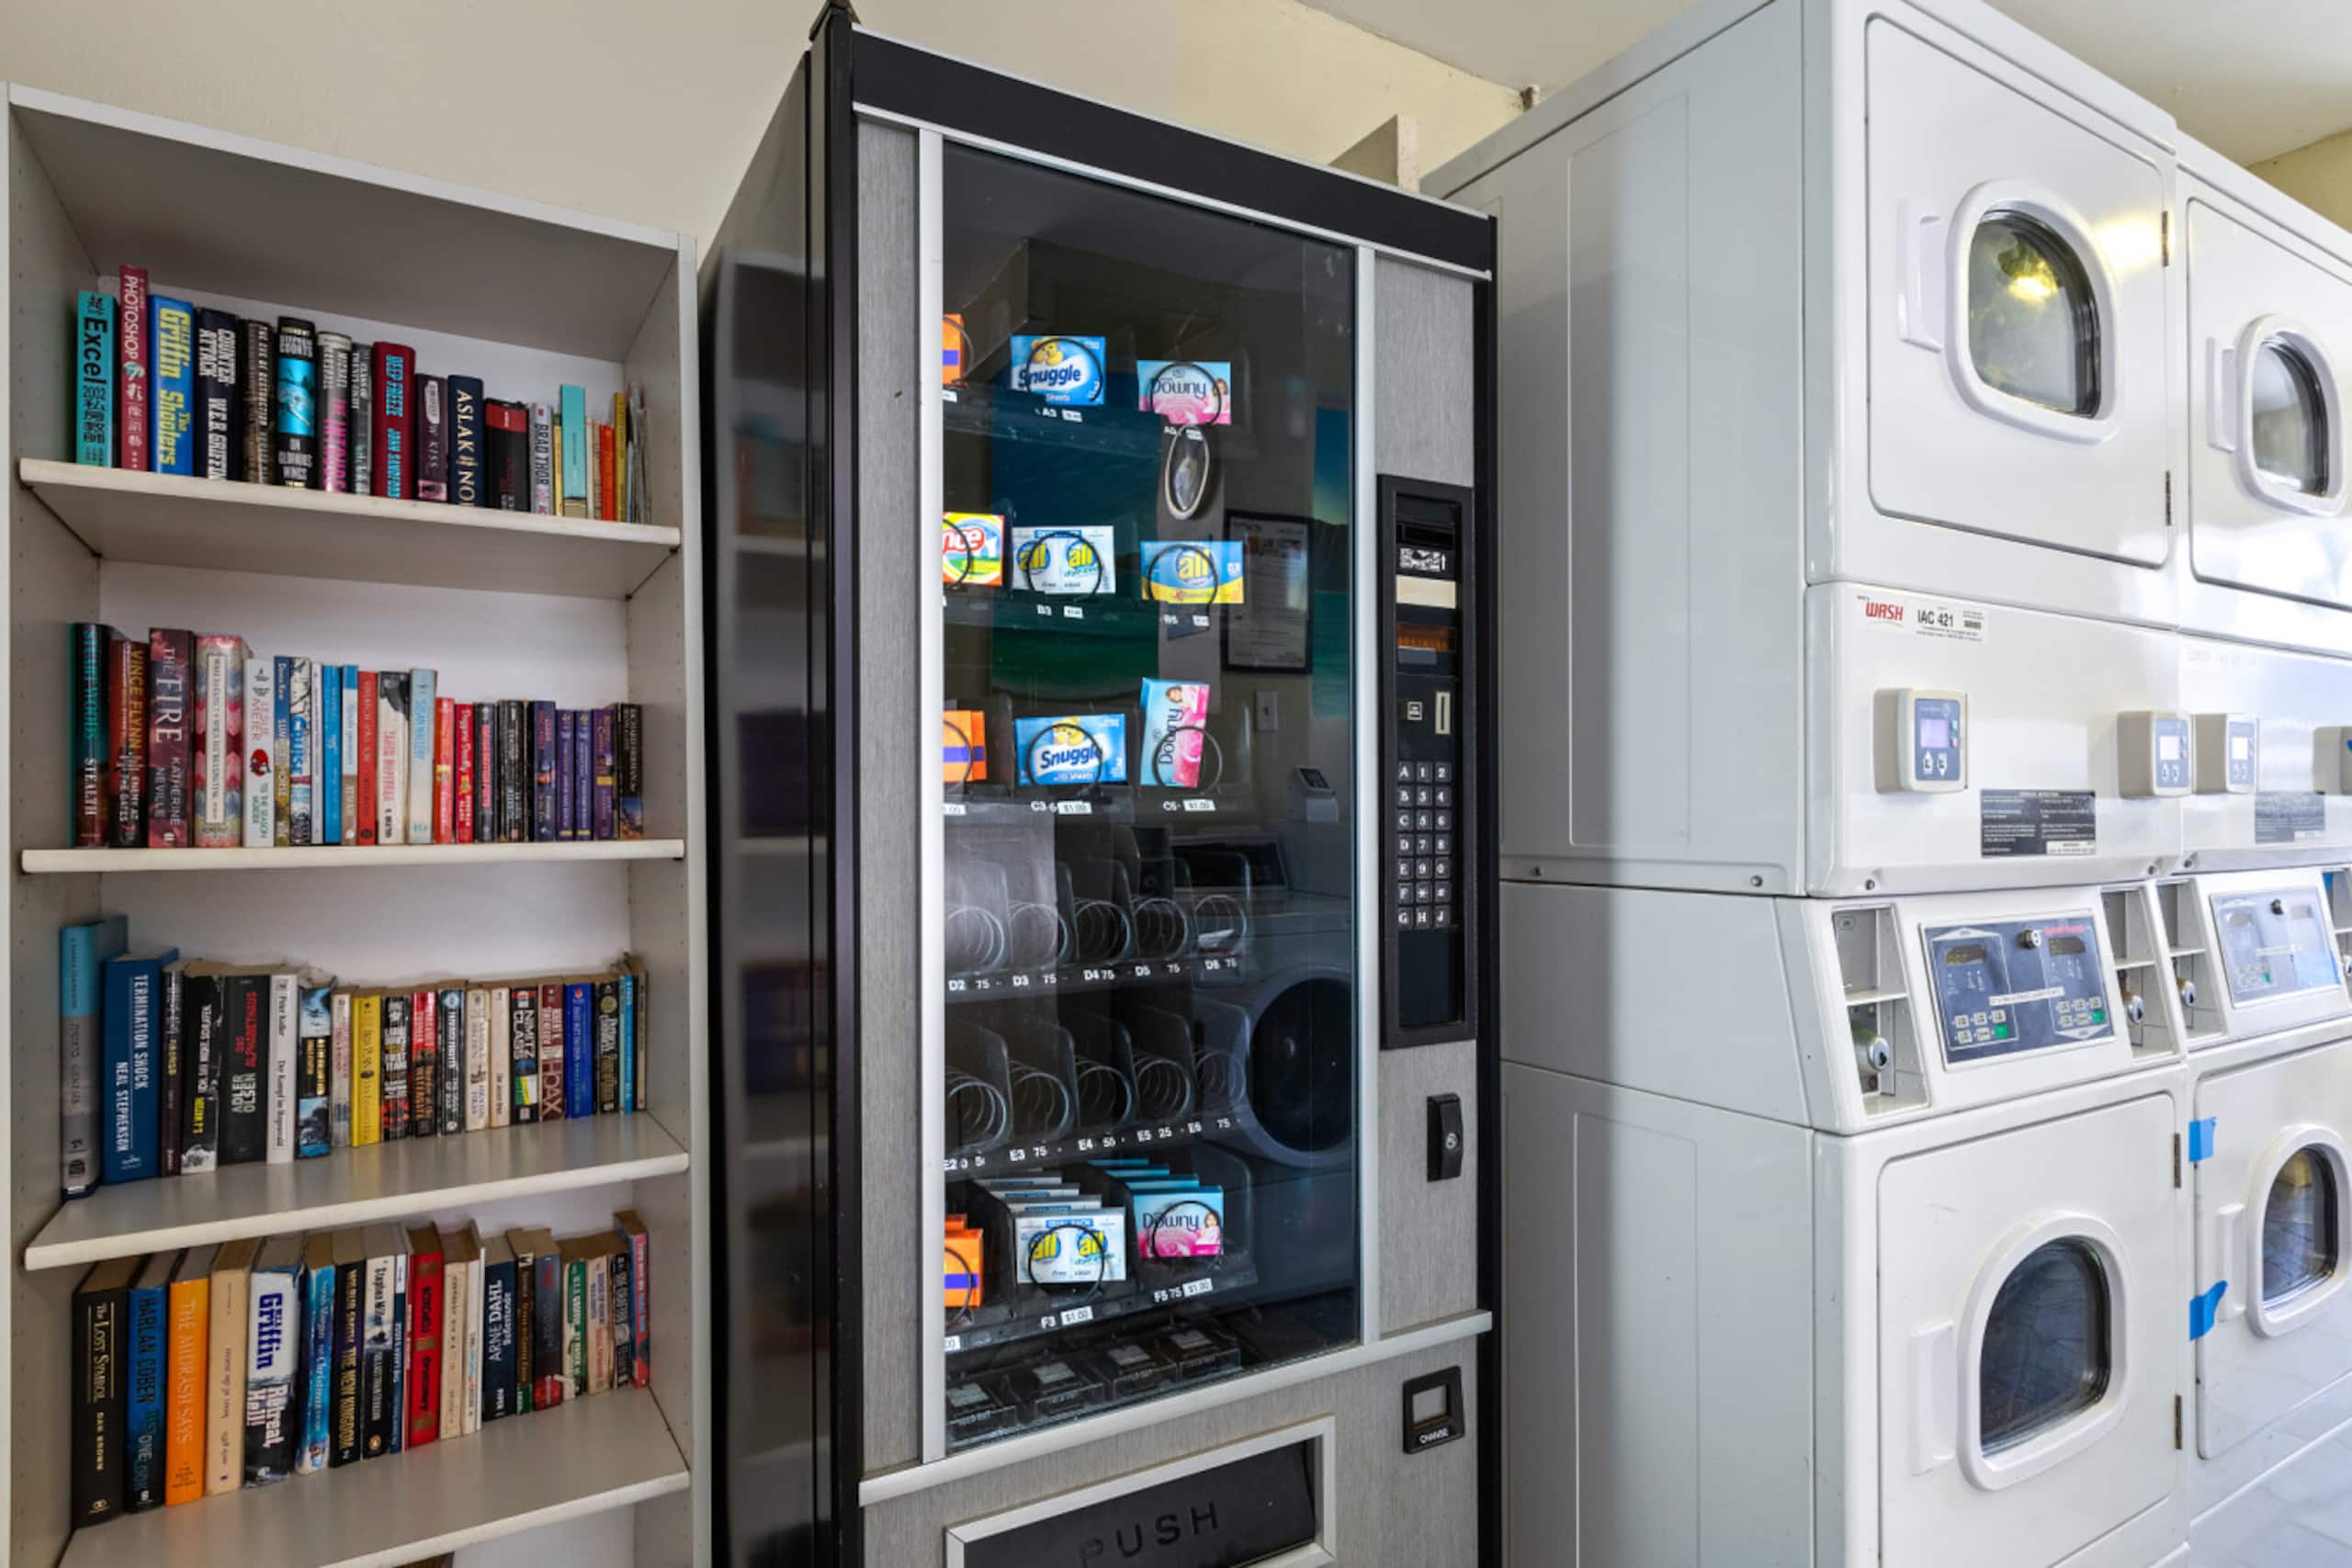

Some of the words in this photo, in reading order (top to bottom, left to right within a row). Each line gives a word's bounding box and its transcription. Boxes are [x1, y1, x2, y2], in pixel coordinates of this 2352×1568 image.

[123, 274, 140, 360] PHOTOSHOP
[84, 316, 108, 384] Excel
[160, 309, 192, 378] Griffin
[198, 328, 218, 378] ATTACK
[386, 354, 403, 381] DEEP
[1017, 365, 1081, 387] Snuggle
[386, 381, 403, 418] FREEZE
[1155, 379, 1206, 398] Downy
[160, 390, 184, 466] Shooters
[388, 428, 401, 451] JOHN
[457, 389, 476, 454] ASLAK
[535, 423, 549, 455] BRAD
[208, 432, 227, 480] GRIFFIN
[536, 456, 549, 486] THOR
[388, 453, 401, 498] SANDFORD
[943, 530, 983, 549] nce
[1017, 542, 1047, 570] all
[1069, 542, 1094, 567] all
[1178, 550, 1207, 579] all
[1865, 602, 1905, 622] WASH
[1917, 609, 1935, 626] IAC
[1938, 612, 1954, 627] 421
[130, 649, 144, 694] VINCE
[163, 647, 175, 675] THE
[130, 700, 142, 750] FLYNN
[154, 677, 183, 744] FIRE
[251, 697, 262, 740] MEIER
[1159, 707, 1183, 766] Downy
[84, 757, 98, 817] STEALTH
[153, 766, 165, 818] NEVILLE
[170, 756, 182, 827] KATHERINE
[1013, 976, 1029, 987] D3
[1042, 973, 1057, 984] 75
[1084, 970, 1100, 981] D4
[1101, 969, 1115, 980] 75
[1135, 965, 1150, 976] D5
[1167, 964, 1181, 974] 75
[1225, 958, 1238, 968] 75
[949, 979, 966, 990] D2
[133, 975, 149, 1049] TERMINATION
[513, 1010, 524, 1060] CLASS
[524, 1010, 535, 1059] NIMITZ
[116, 1062, 129, 1087] NEAL
[133, 1052, 149, 1090] SHOCK
[543, 1059, 563, 1114] HOAX
[232, 1075, 244, 1113] ADLER
[243, 1073, 256, 1113] OLSEN
[116, 1090, 129, 1152] STEPHENSON
[1136, 1130, 1151, 1142] E5
[1216, 1118, 1231, 1129] 75
[1010, 1149, 1025, 1162] E3
[1033, 1146, 1047, 1157] 75
[1079, 1140, 1093, 1151] E4
[1142, 1211, 1199, 1230] Downy
[1029, 1233, 1058, 1260] all
[1078, 1231, 1104, 1255] all
[345, 1269, 357, 1309] WILBUR
[373, 1267, 387, 1302] Stephen
[489, 1279, 503, 1323] DAHL
[1154, 1290, 1168, 1303] F5
[138, 1298, 156, 1353] HARLAN
[178, 1300, 196, 1329] THE
[256, 1292, 283, 1370] Griffin
[345, 1311, 356, 1344] SMITH
[341, 1347, 356, 1369] THE
[489, 1324, 503, 1361] ARNE
[136, 1359, 156, 1404] COBEN
[176, 1335, 194, 1404] MIDRASH
[315, 1356, 327, 1411] Christmas
[340, 1370, 356, 1395] NEW
[246, 1388, 266, 1427] Hell!
[264, 1384, 288, 1450] Retreat,
[339, 1397, 356, 1450] KINGDOM
[176, 1409, 193, 1445] SAYS
[138, 1435, 153, 1461] ONE
[1080, 1500, 1217, 1568] PUSH
